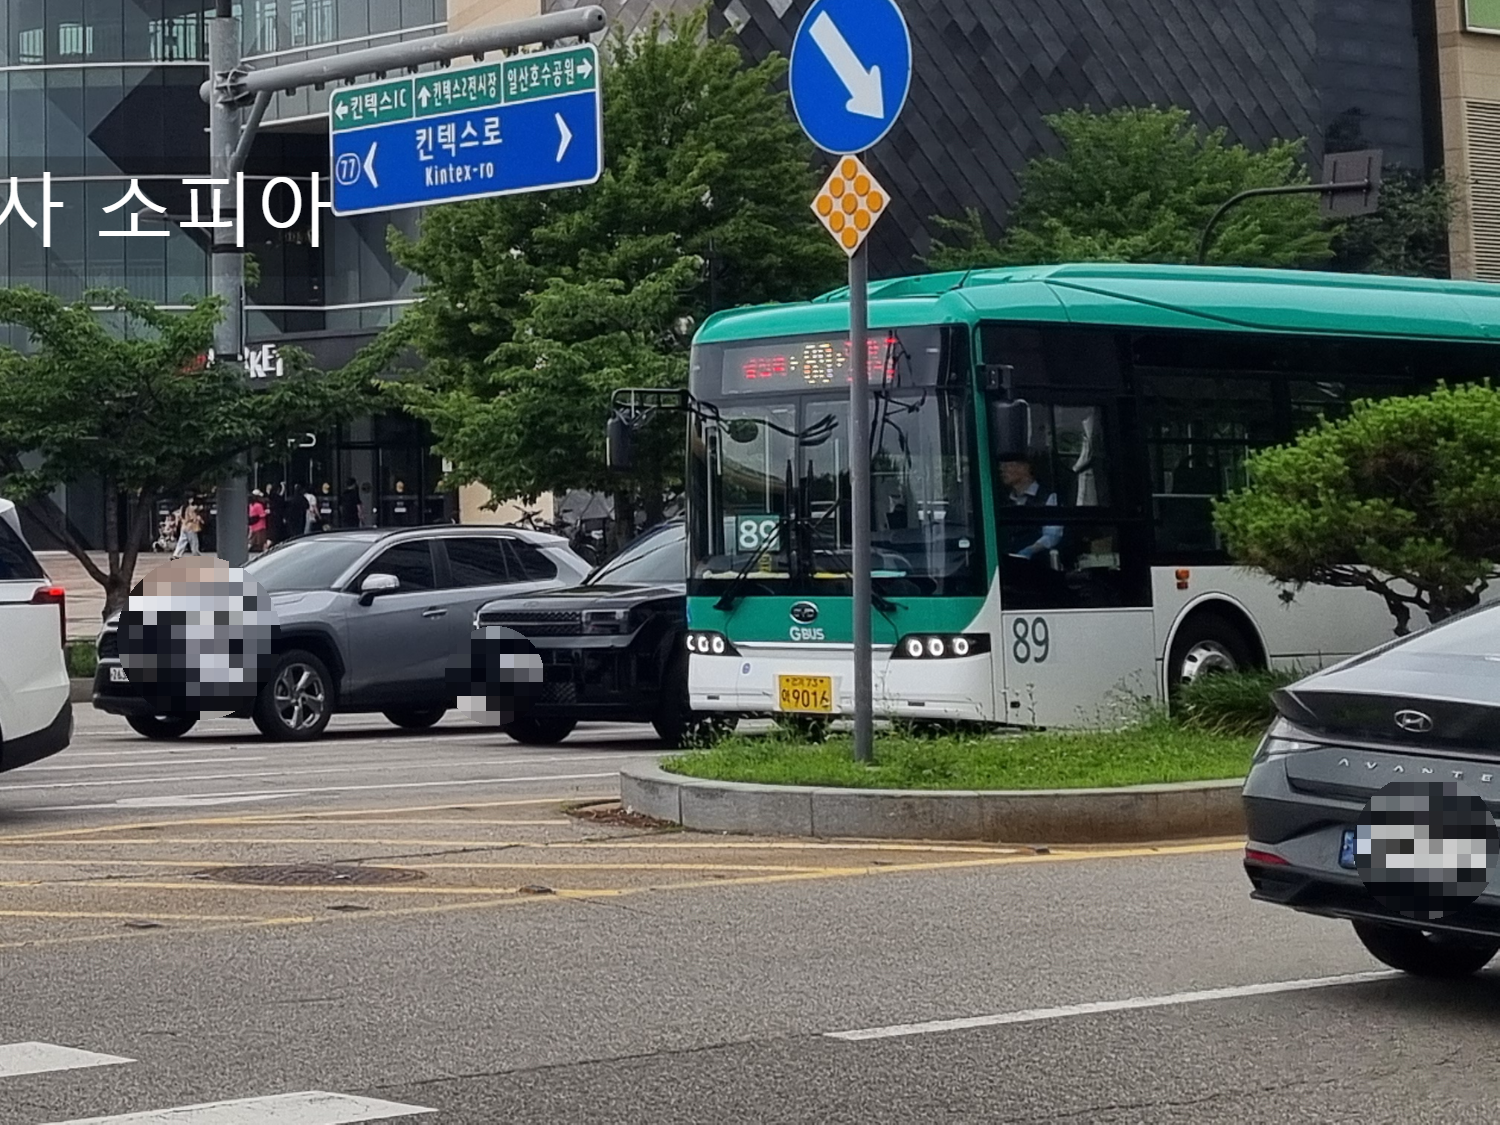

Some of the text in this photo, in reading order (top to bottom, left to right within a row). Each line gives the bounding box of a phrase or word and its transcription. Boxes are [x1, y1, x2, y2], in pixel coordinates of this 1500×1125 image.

[433, 75, 498, 106] 킨텍스2전시장
[508, 58, 575, 96] 일산호수공원
[349, 88, 407, 120] 킨텍스IC
[415, 117, 503, 161] 킨텍스로
[341, 160, 356, 177] 77
[425, 162, 494, 187] Kintex-ro
[740, 520, 778, 548] 89
[1012, 617, 1050, 664] 89
[1338, 758, 1493, 783] AVANTE
